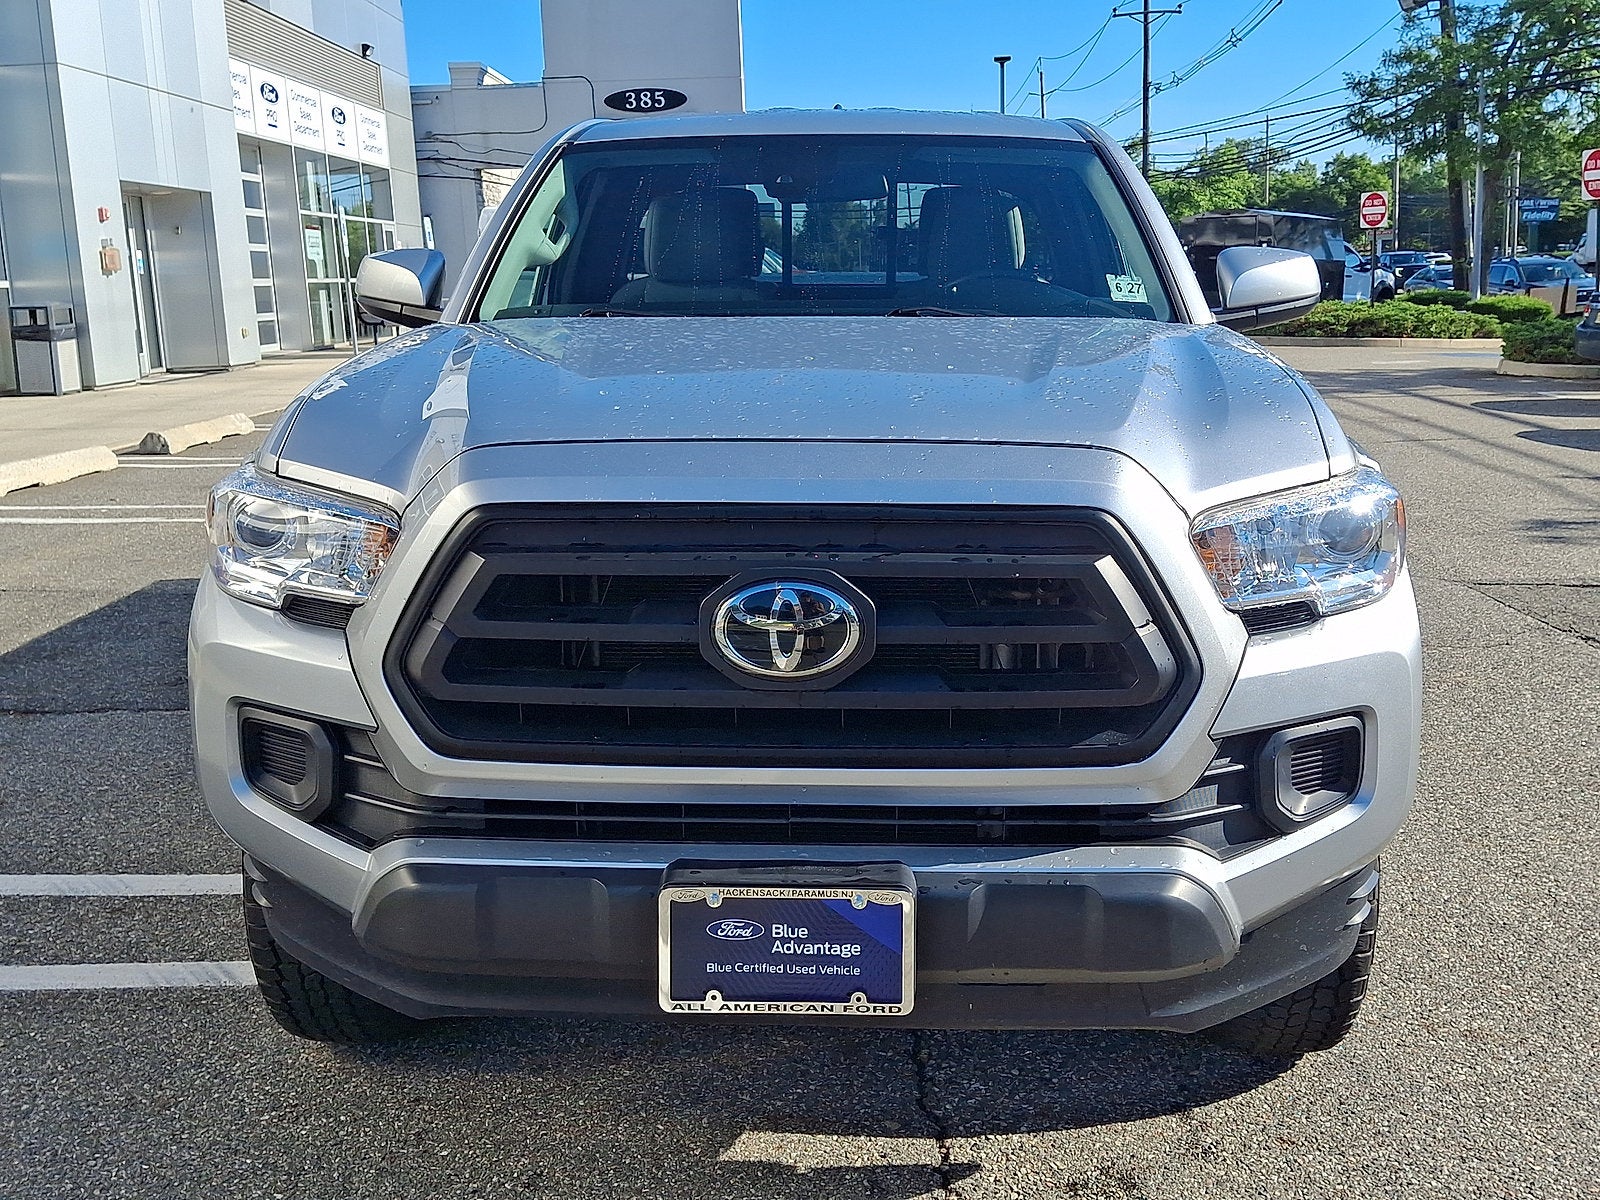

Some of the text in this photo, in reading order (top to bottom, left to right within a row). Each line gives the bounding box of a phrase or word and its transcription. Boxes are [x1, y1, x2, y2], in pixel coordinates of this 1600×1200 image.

[625, 91, 666, 109] 385
[1587, 160, 1596, 169] DO
[1373, 198, 1383, 206] NOT
[1366, 214, 1382, 222] ENTER
[1522, 210, 1556, 221] Fidelity
[1115, 282, 1141, 294] 6 27
[677, 890, 700, 900] Ford
[841, 890, 854, 898] NJ
[874, 892, 897, 902] Ford
[716, 919, 808, 939] Ford Blue
[771, 940, 861, 958] Advantage
[706, 962, 861, 976] Blue Certified Used Vehicle
[671, 1002, 902, 1014] ALL AMERICAN FORD
